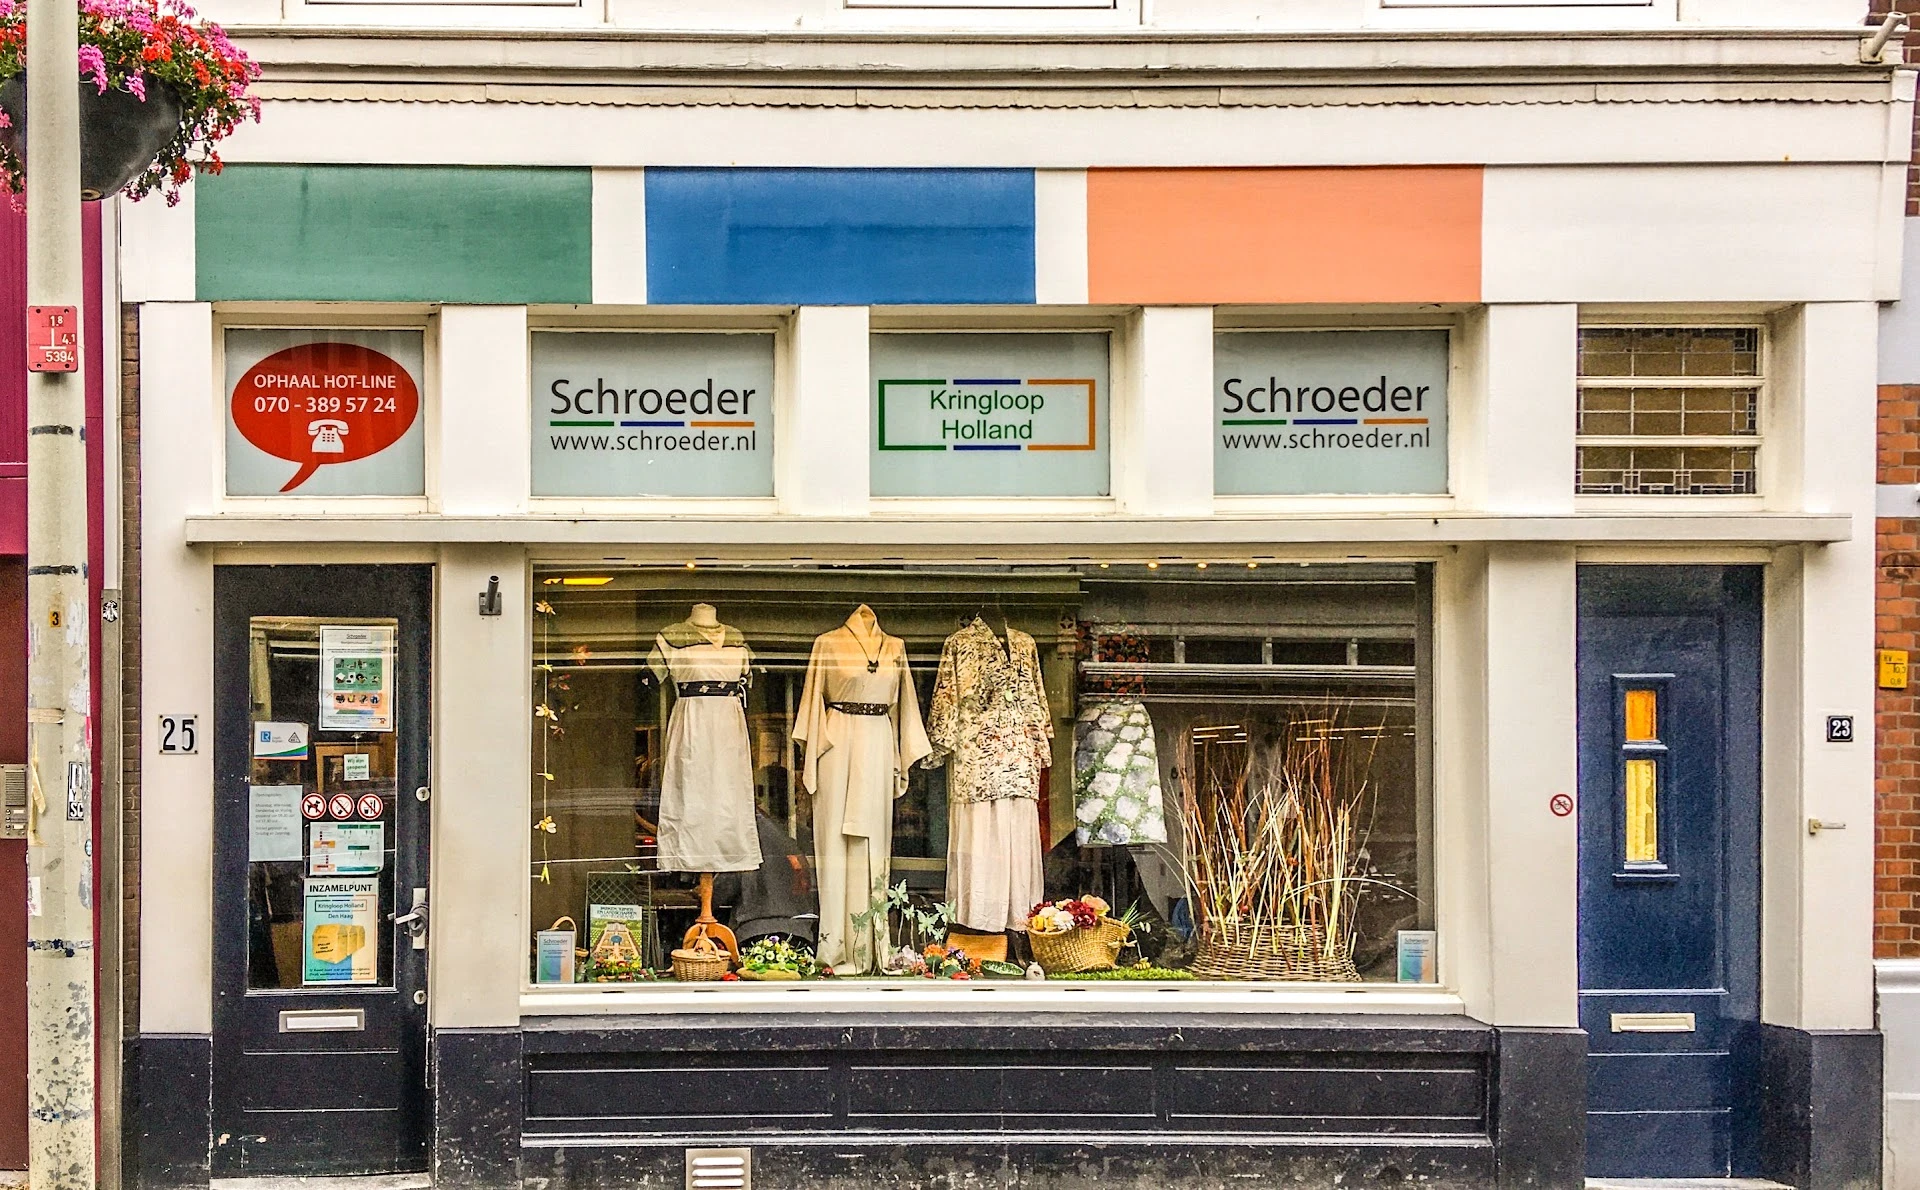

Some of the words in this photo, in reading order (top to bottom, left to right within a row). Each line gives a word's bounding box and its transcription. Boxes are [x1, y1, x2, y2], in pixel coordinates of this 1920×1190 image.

[45, 350, 75, 363] 5394
[254, 374, 320, 389] OPHAAL
[324, 375, 396, 389] HOT-LINE
[550, 377, 756, 415] Schroeder
[930, 389, 1044, 415] Kringloop
[1222, 375, 1430, 413] Schroeder
[254, 396, 290, 413] 070
[306, 396, 341, 413] 389
[345, 397, 369, 413] 57
[373, 397, 397, 413] 24
[941, 419, 1033, 440] Holland
[1222, 427, 1430, 449] www.schroeder.nl
[550, 430, 756, 451] www.schroeder.nl
[52, 611, 59, 626] 3
[162, 717, 195, 751] 25
[1832, 719, 1851, 737] 23
[309, 884, 373, 893] INZAMELPUNT
[318, 902, 343, 910] Kringloop
